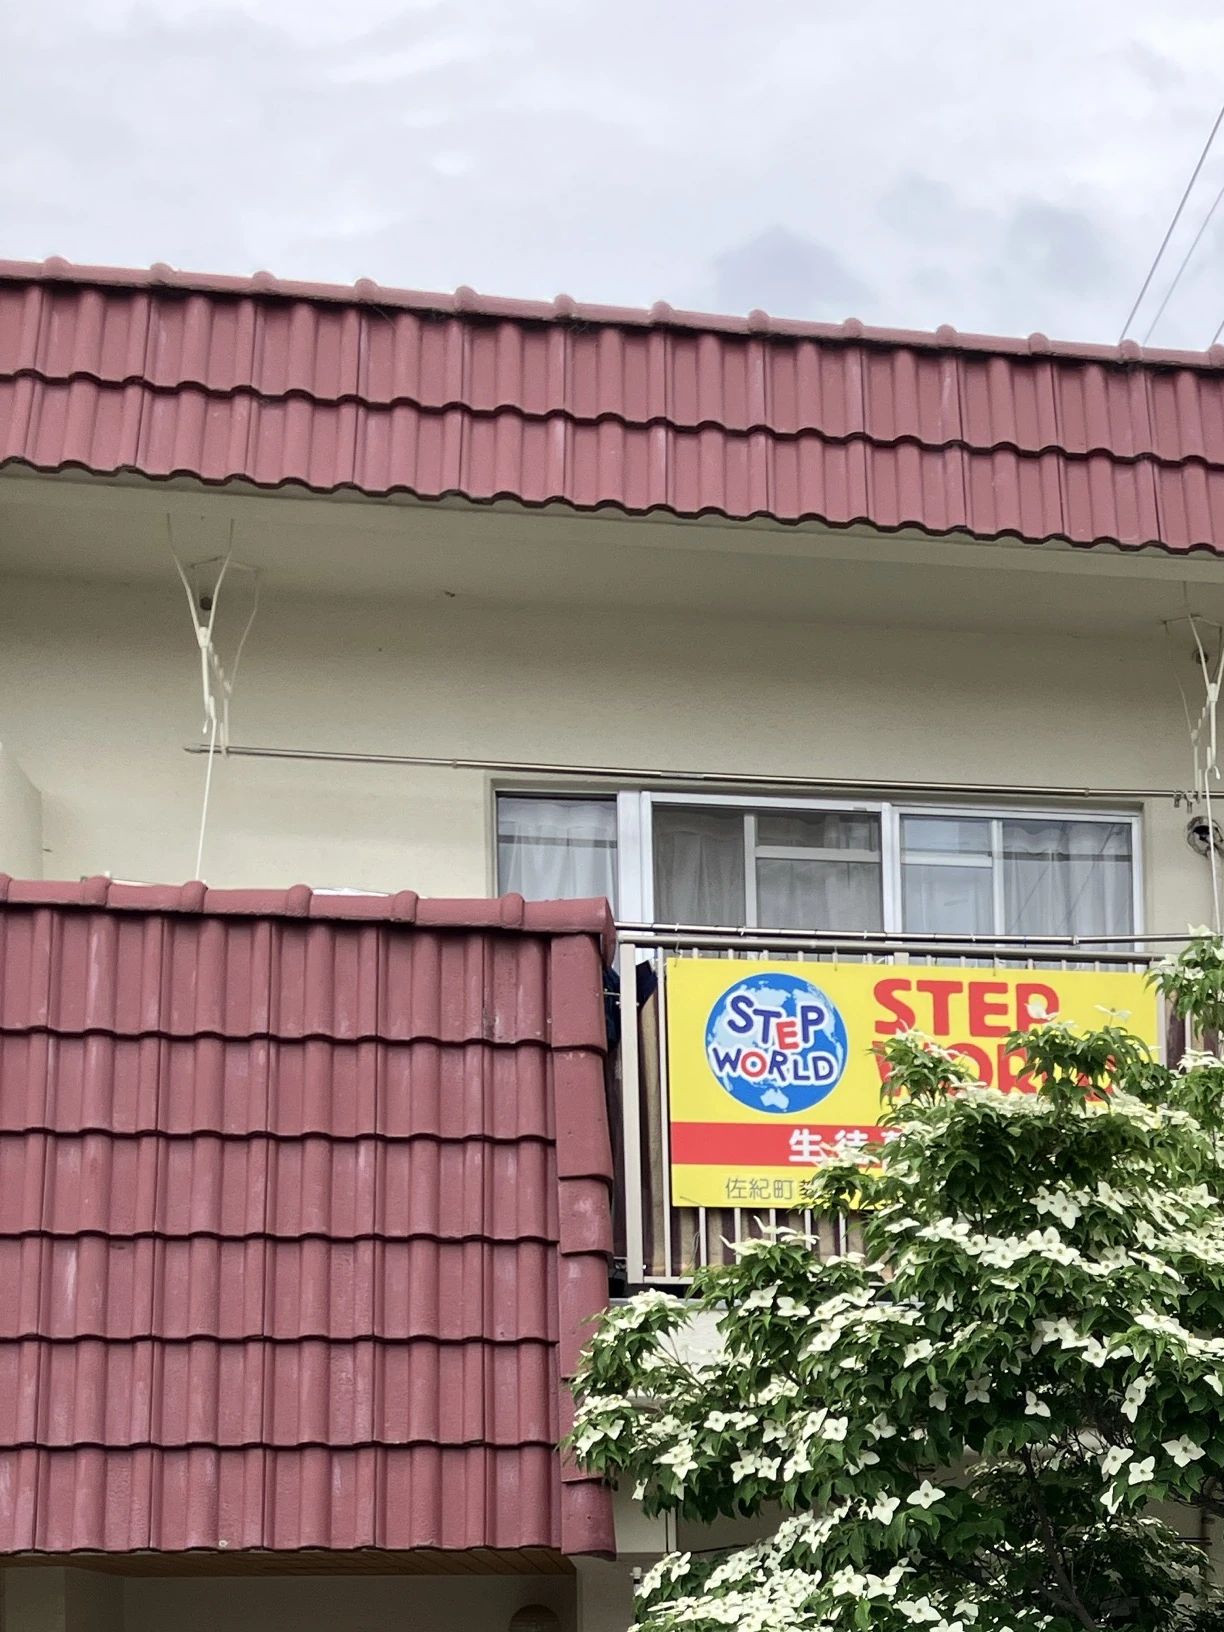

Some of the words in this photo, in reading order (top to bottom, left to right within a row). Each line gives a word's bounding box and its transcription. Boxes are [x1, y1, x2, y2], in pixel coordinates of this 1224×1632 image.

[727, 994, 826, 1050] STEP
[873, 978, 1060, 1038] STEP
[712, 1047, 835, 1082] WORLD
